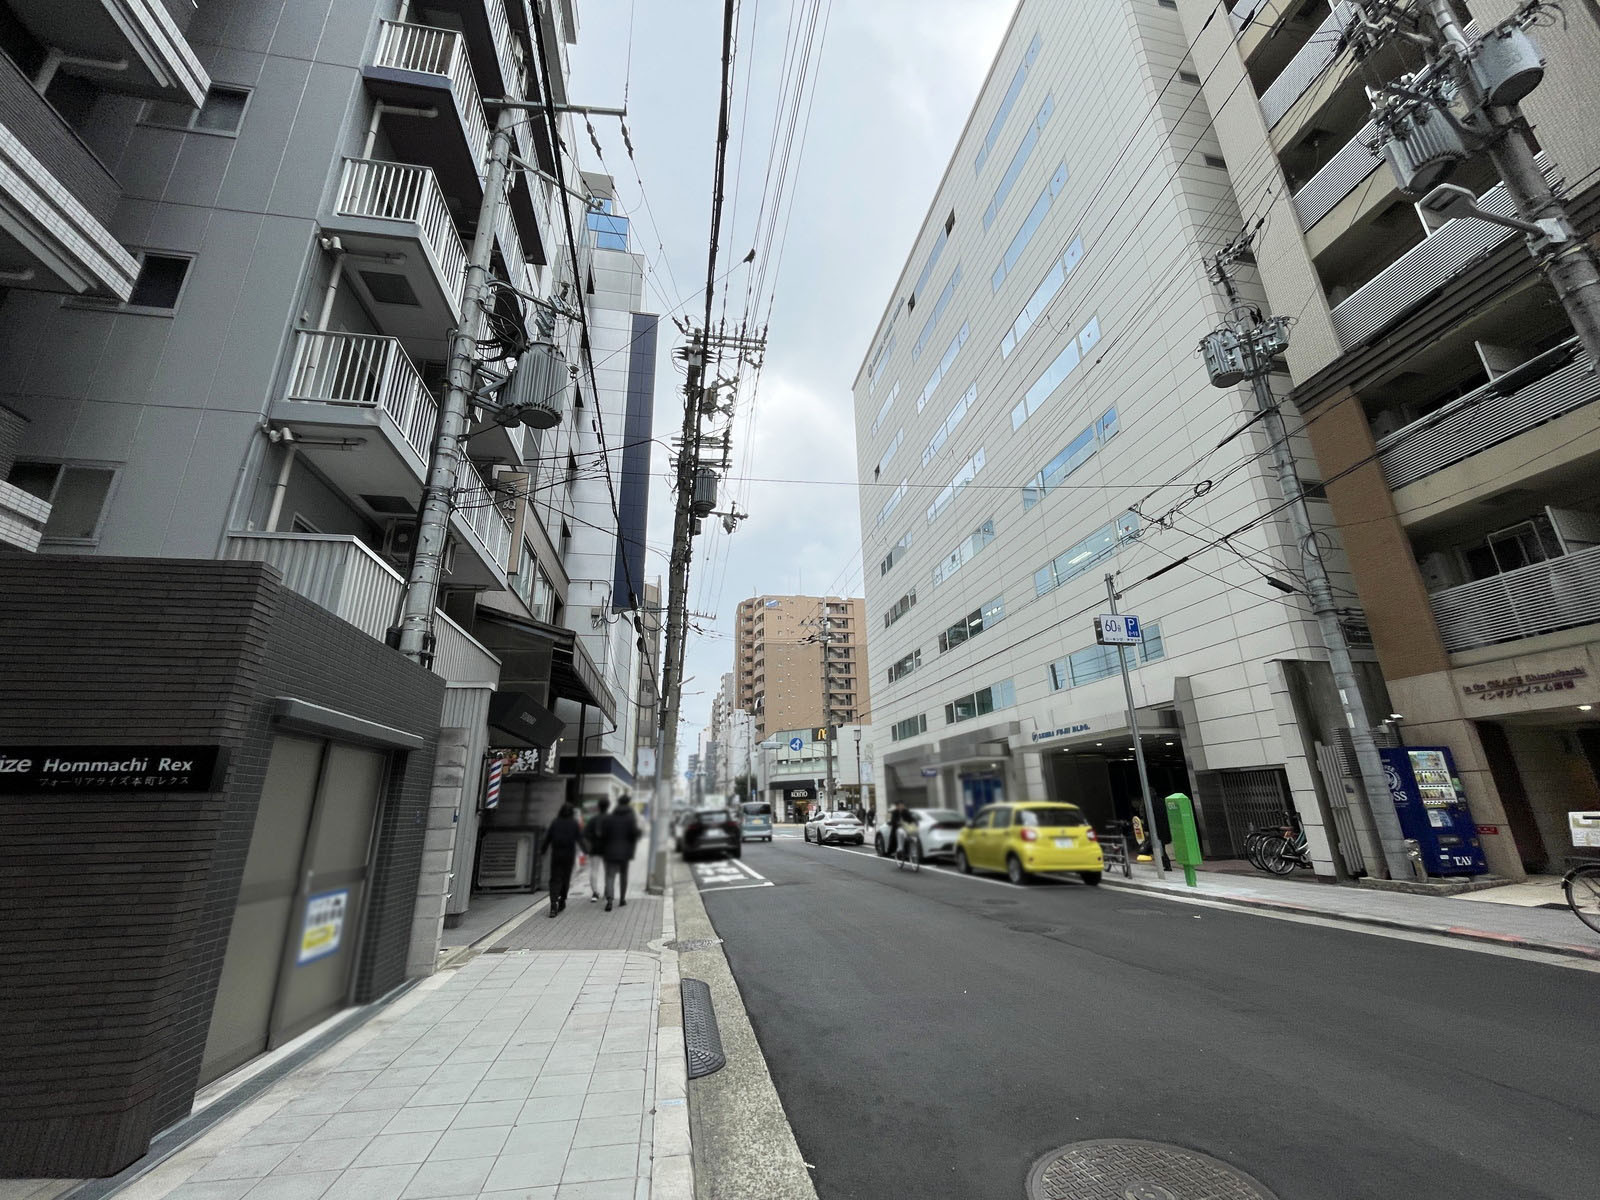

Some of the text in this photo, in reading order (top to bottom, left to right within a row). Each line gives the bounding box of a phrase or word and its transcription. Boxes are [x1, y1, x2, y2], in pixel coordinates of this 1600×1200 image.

[1128, 618, 1135, 631] P
[43, 757, 149, 772] Hommachi
[158, 757, 193, 772] Rex
